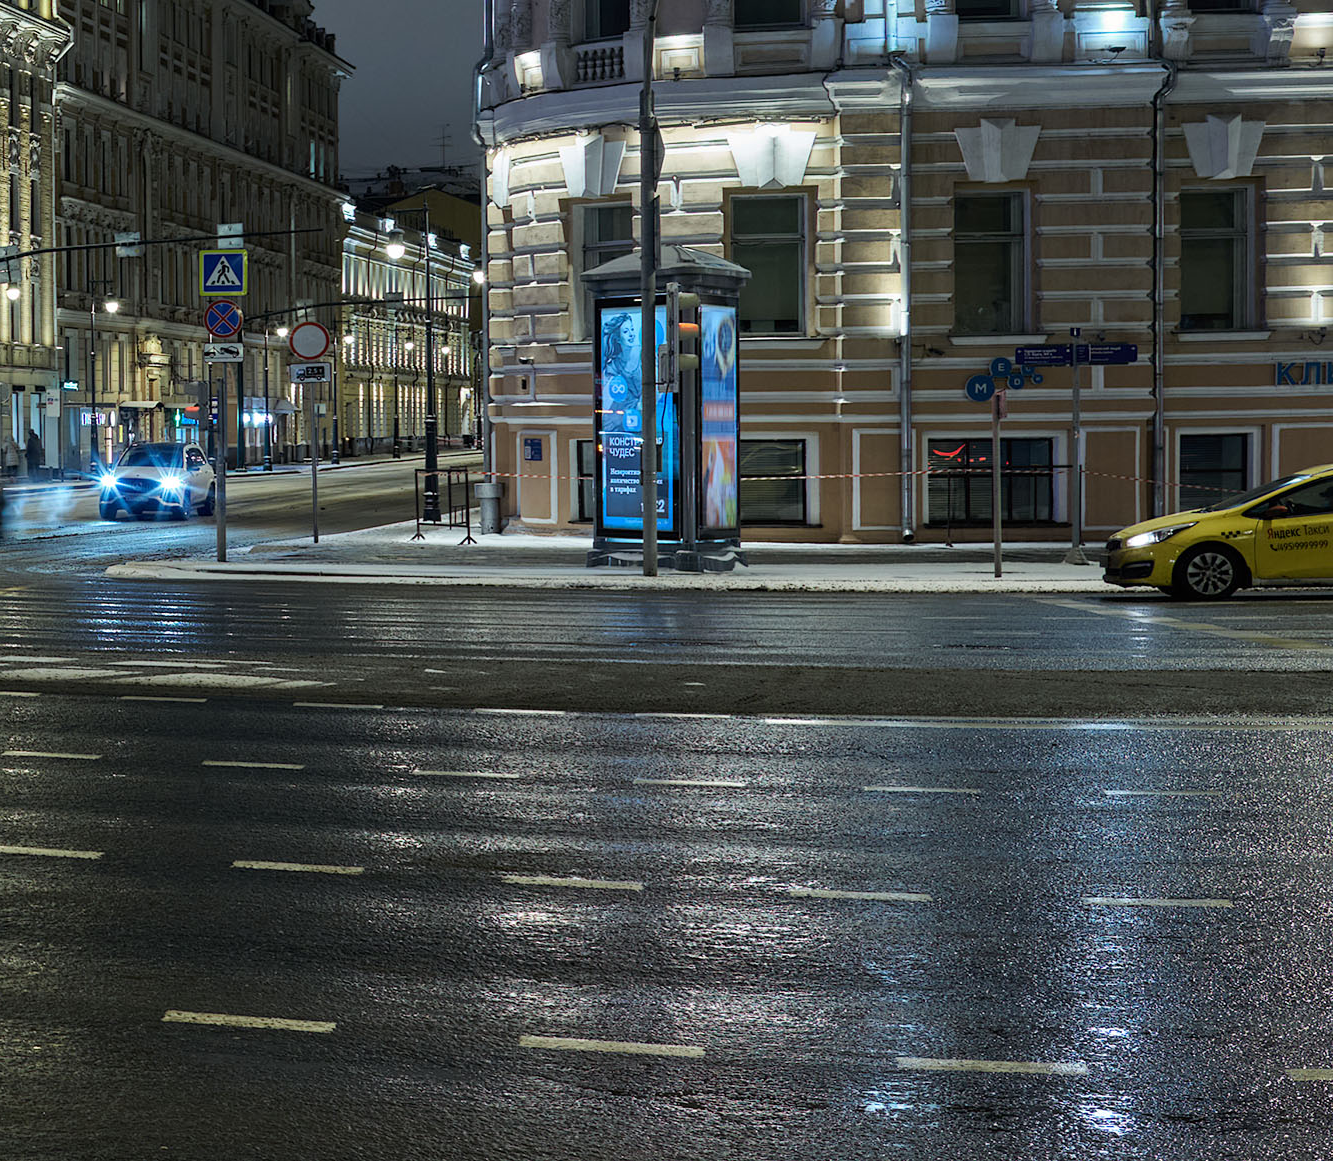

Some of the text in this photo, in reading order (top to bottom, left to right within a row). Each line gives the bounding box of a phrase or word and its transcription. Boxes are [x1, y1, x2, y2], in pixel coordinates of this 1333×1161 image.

[609, 448, 635, 458] ЧУДЕС
[1267, 524, 1330, 539] Яндекс Такси
